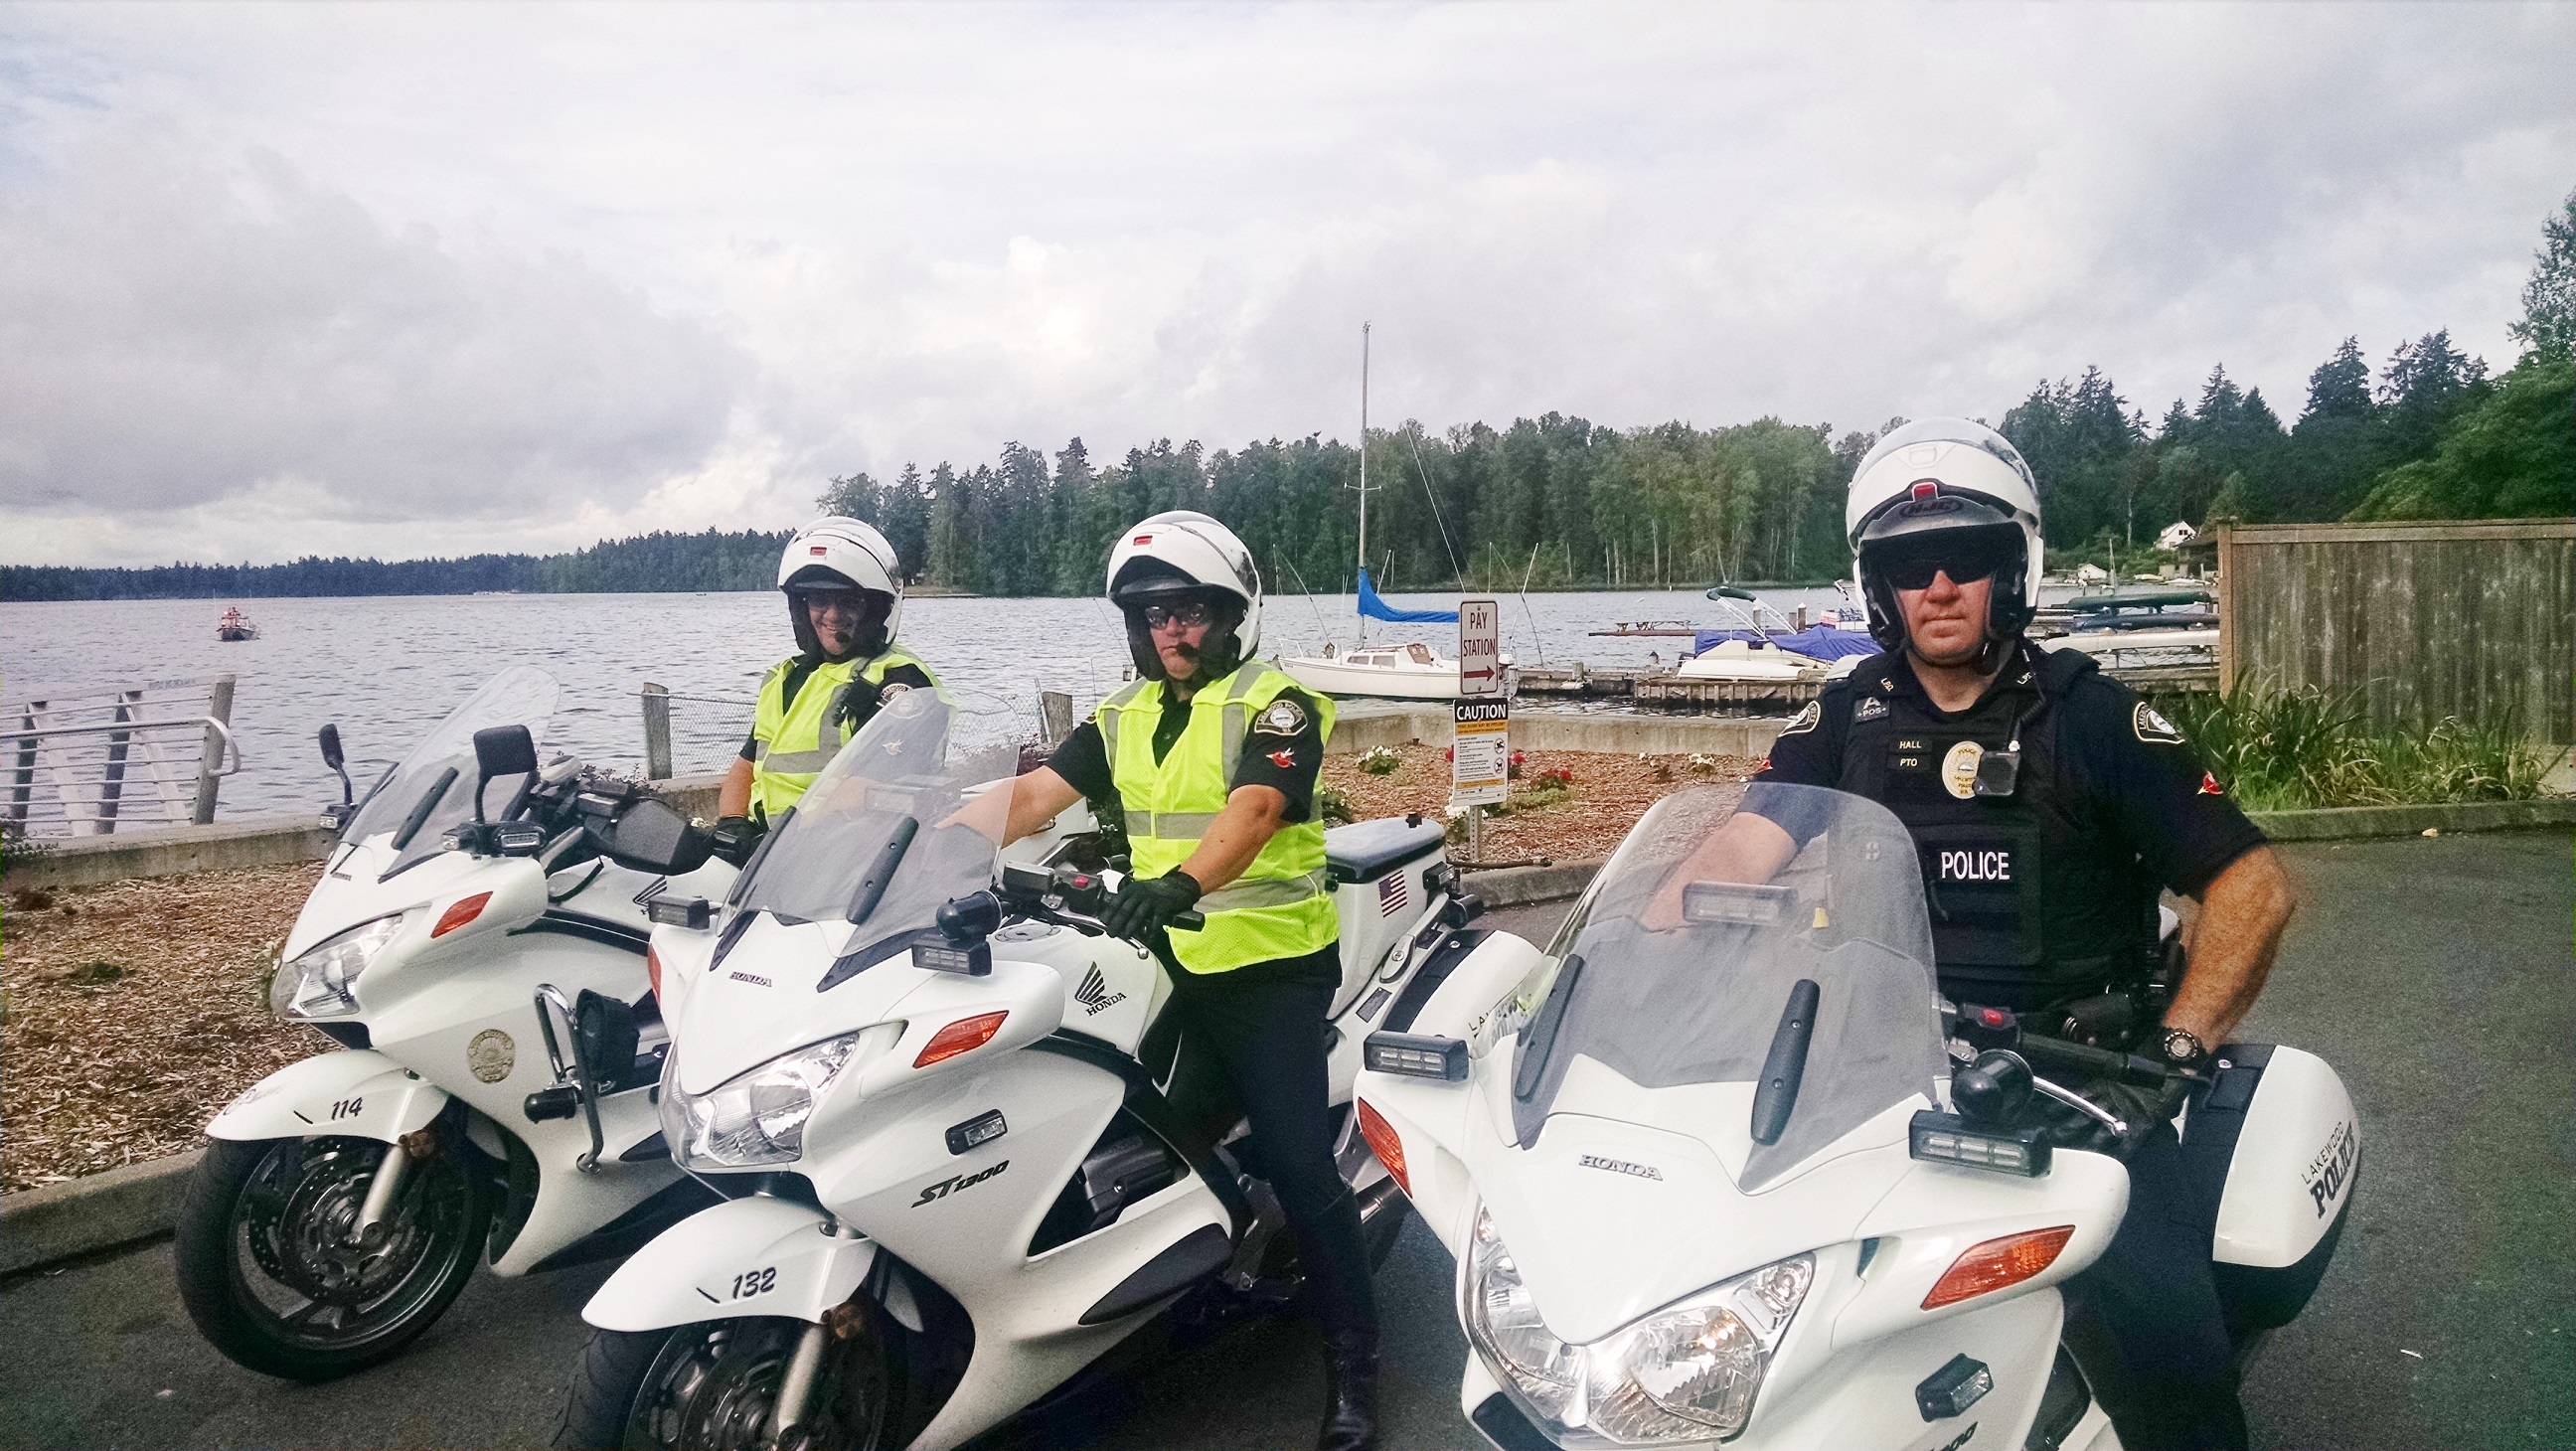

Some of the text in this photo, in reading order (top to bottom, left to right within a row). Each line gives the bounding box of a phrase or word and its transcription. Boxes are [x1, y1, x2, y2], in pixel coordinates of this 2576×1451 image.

[1470, 612, 1488, 629] PAY
[1463, 638, 1496, 657] STATION
[1456, 704, 1507, 721] CAUTION
[1862, 697, 1881, 710] A
[1899, 740, 1922, 749] HALL
[1899, 757, 1918, 767] PTO
[1941, 851, 2011, 881] POLICE
[728, 971, 772, 988] HONDA
[1085, 992, 1127, 1017] HONDA
[331, 1096, 363, 1121] 114
[2301, 1121, 2344, 1185] LAKEWOOD
[1578, 1154, 1664, 1182] HONDA
[910, 1159, 1011, 1209] ST1300
[732, 1266, 777, 1300] 132
